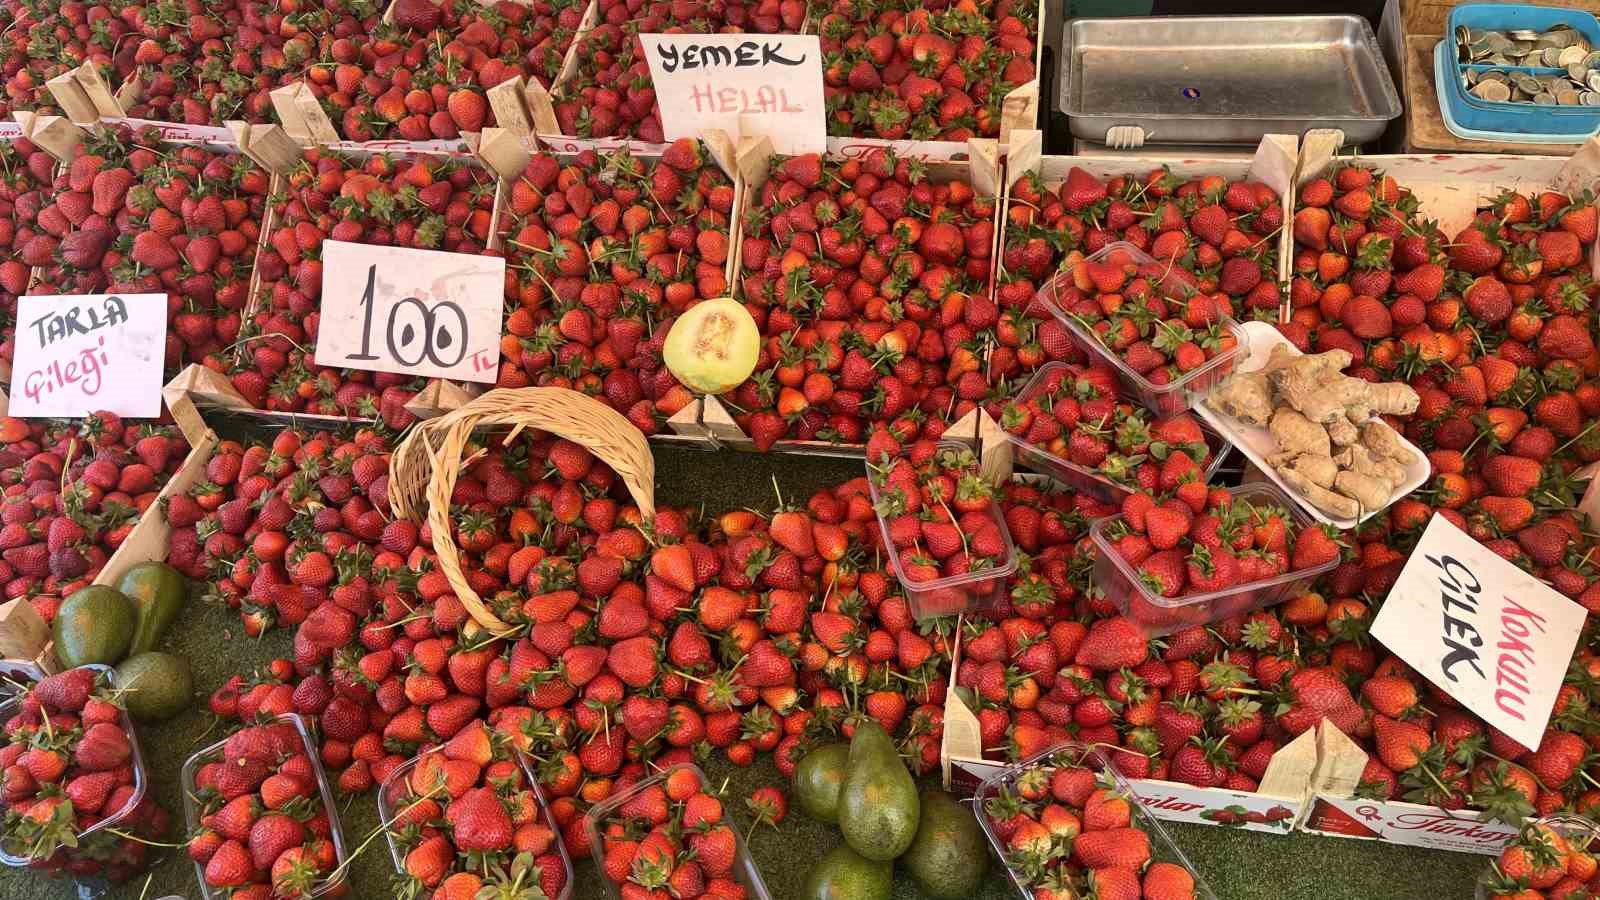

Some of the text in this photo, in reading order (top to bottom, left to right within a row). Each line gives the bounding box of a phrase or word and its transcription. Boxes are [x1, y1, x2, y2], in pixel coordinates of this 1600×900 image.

[657, 41, 806, 73] YEMEK
[690, 82, 804, 113] HELAL
[29, 296, 128, 349] TARLA
[345, 264, 495, 373] 100 TL
